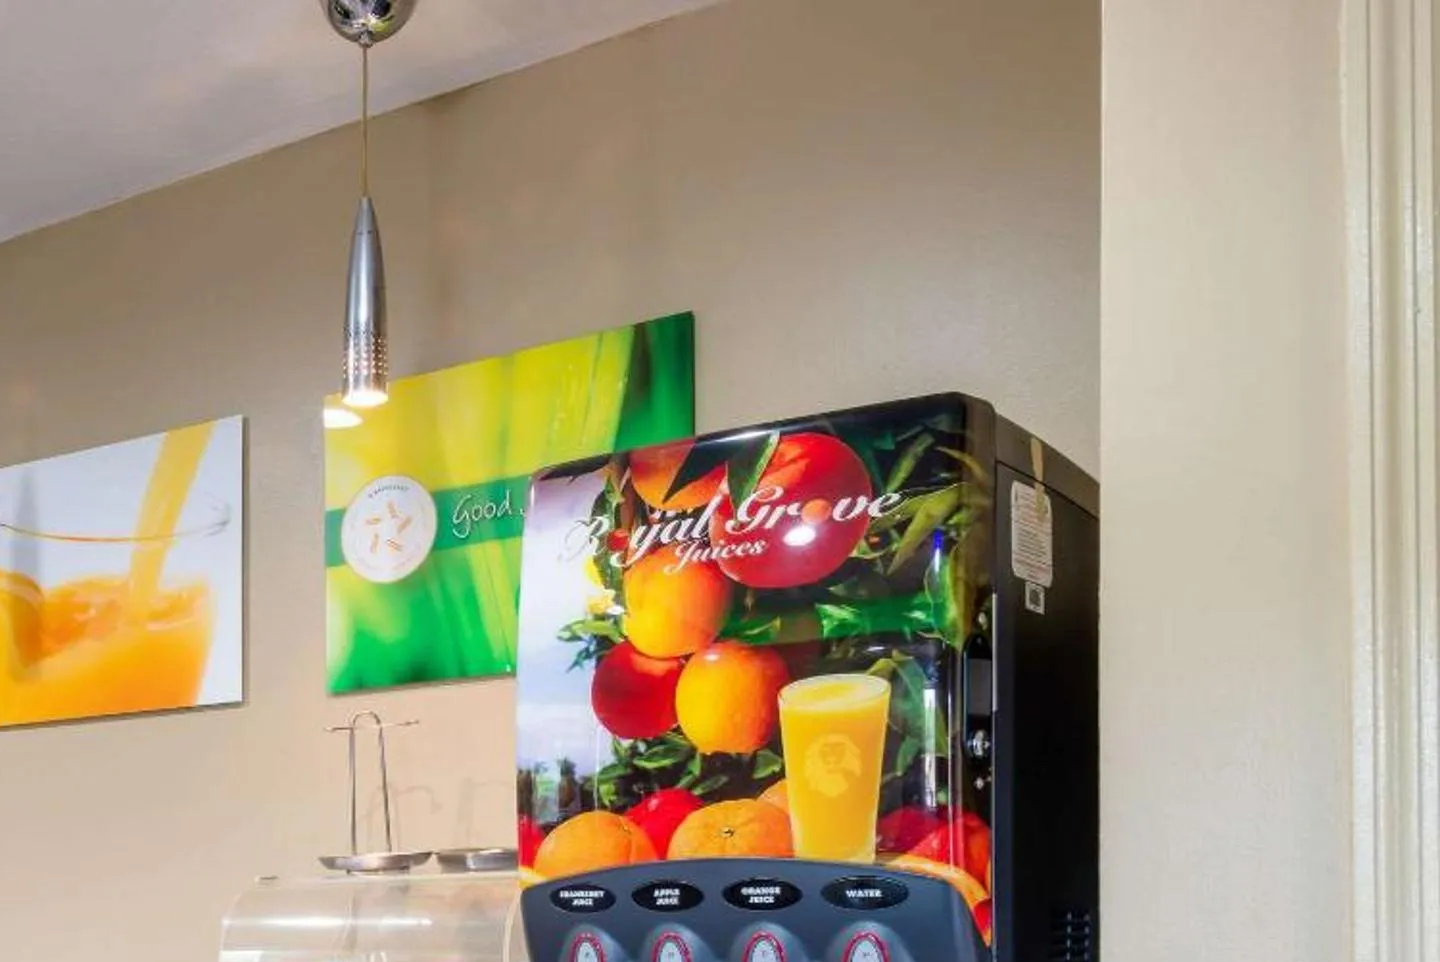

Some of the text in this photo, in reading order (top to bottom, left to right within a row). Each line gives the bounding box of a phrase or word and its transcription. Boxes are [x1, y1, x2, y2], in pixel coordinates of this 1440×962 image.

[452, 488, 512, 538] Good
[558, 485, 903, 568] Royal Grove
[663, 538, 767, 575] Juices
[740, 886, 781, 895] ORANGE
[845, 888, 883, 898] WATER
